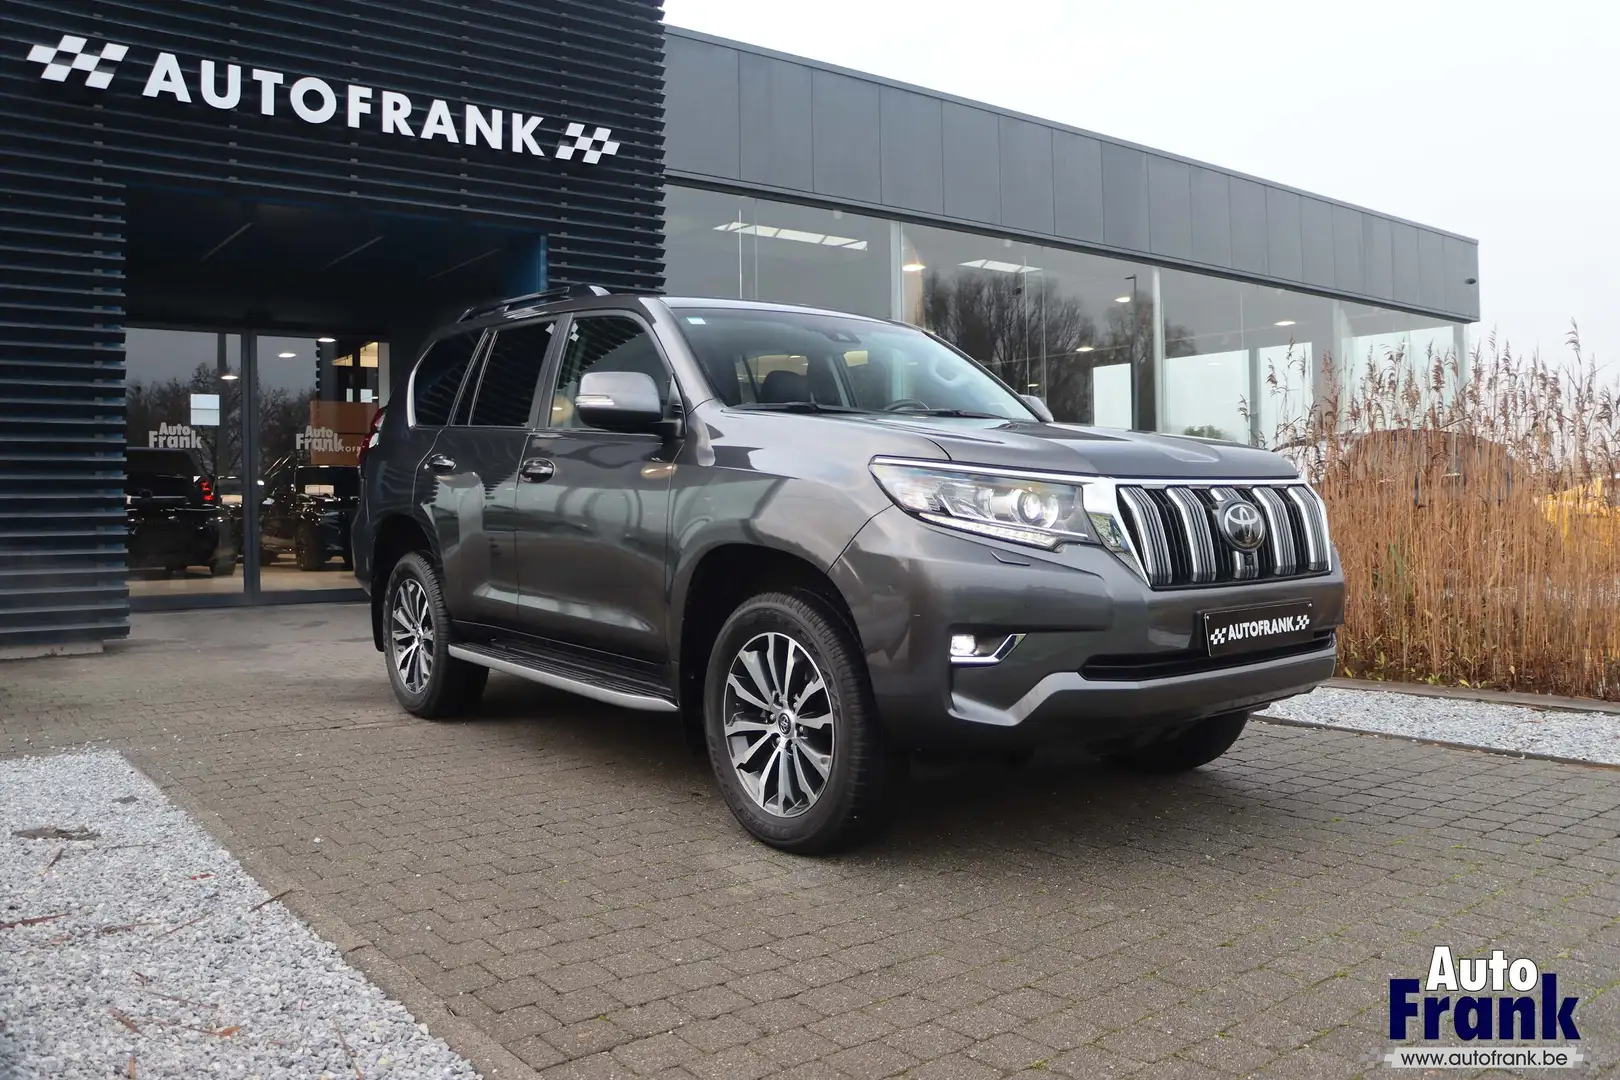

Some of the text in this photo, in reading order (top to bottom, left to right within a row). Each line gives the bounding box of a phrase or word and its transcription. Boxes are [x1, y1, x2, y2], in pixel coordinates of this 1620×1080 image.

[142, 52, 545, 157] AUTOFRANK
[158, 421, 191, 436] Auto
[305, 424, 334, 438] Auto
[148, 429, 203, 449] Frank
[295, 432, 344, 451] Frank
[1228, 616, 1295, 641] AUTOFRANK
